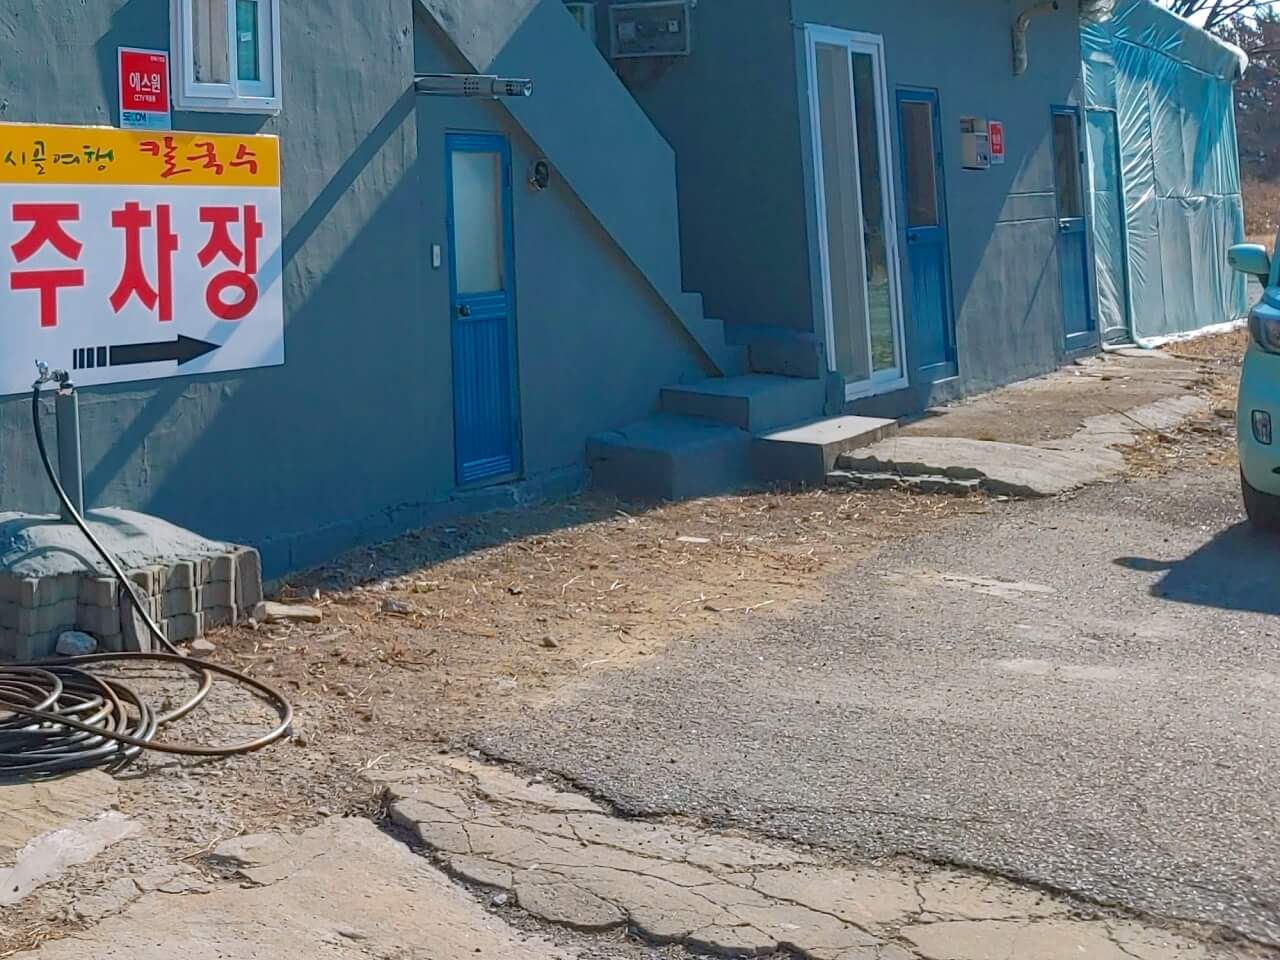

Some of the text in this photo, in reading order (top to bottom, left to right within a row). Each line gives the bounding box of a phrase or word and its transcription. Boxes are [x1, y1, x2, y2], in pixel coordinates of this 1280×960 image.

[129, 72, 160, 93] 에스원
[139, 136, 259, 178] 칼국수
[10, 201, 263, 328] 주차장
